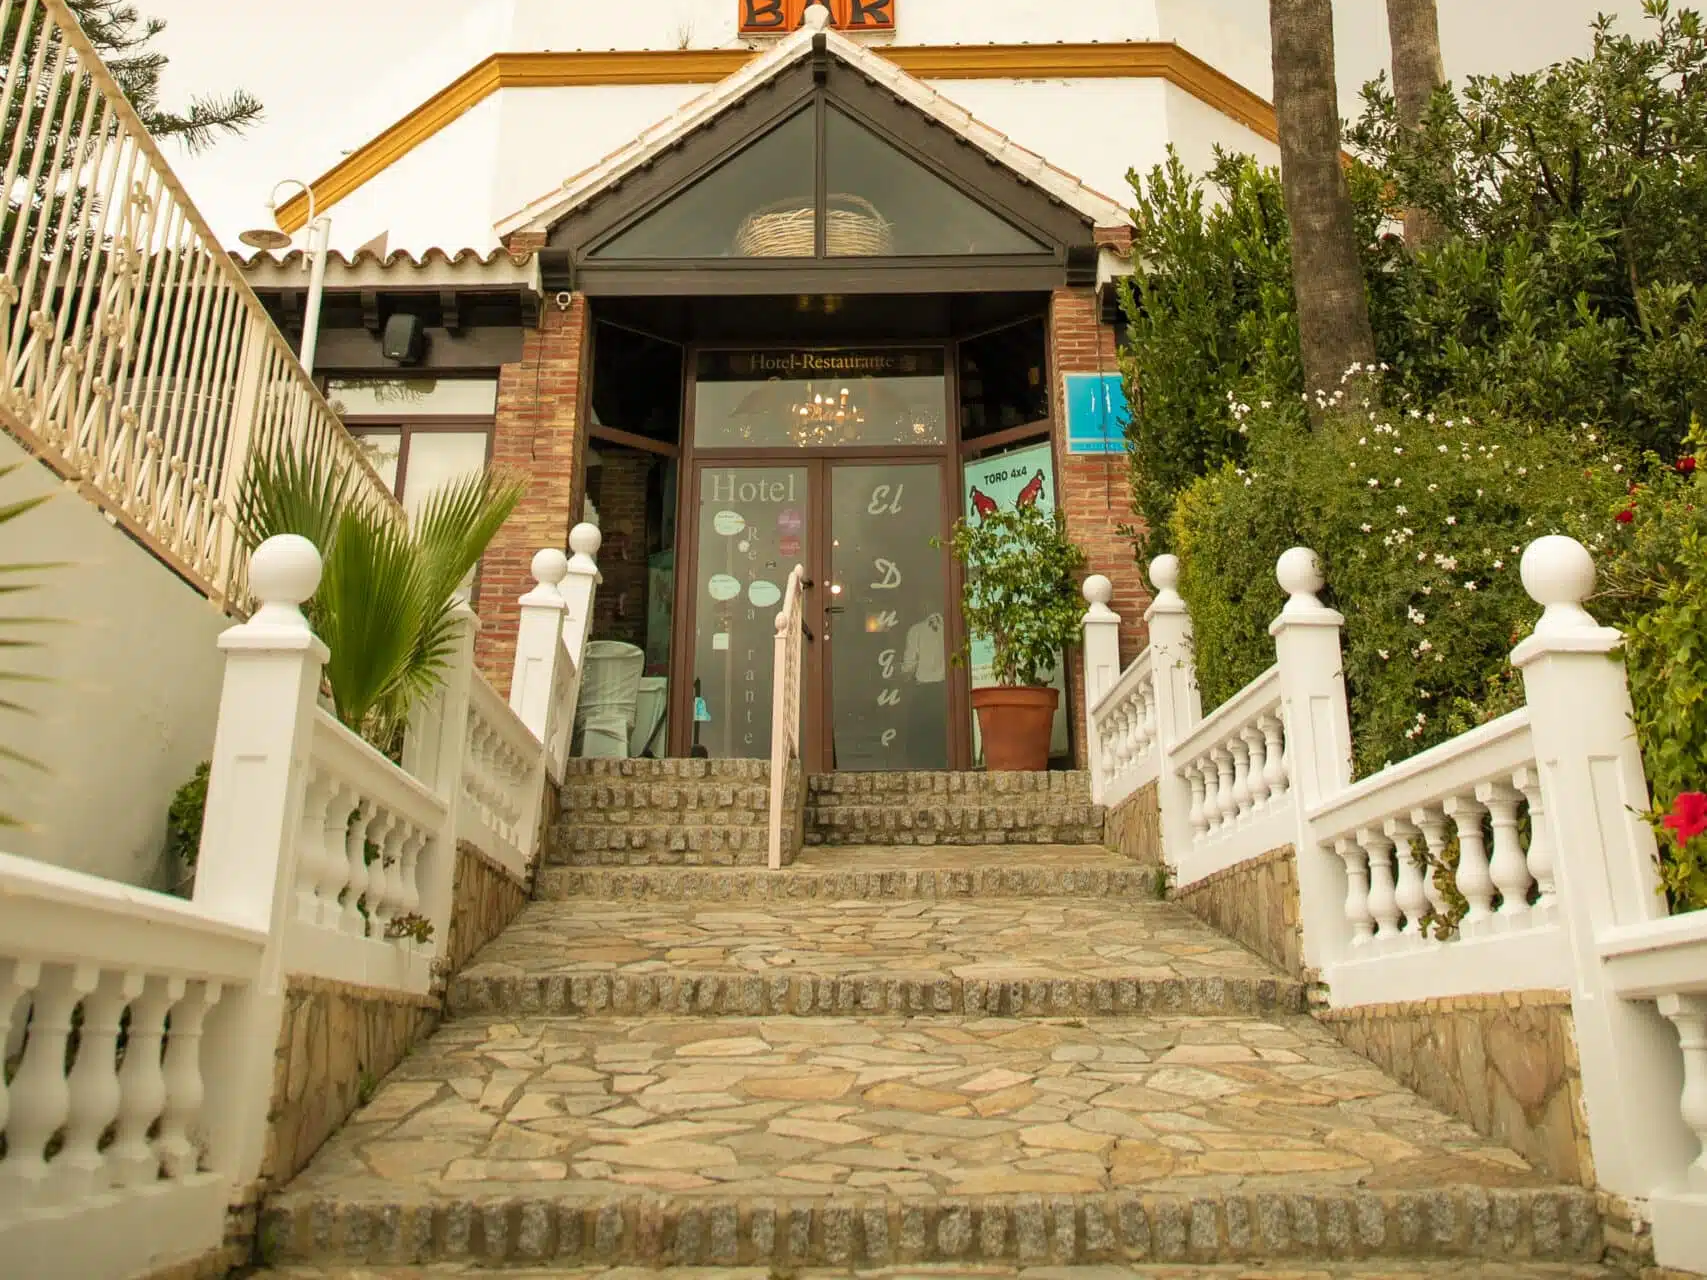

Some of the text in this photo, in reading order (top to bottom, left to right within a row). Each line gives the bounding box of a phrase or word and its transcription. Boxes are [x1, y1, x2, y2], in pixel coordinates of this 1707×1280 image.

[711, 473, 797, 502] Hotel
[984, 466, 1027, 485] TORO 4x4
[867, 483, 904, 514] El
[870, 558, 902, 746] Duque
